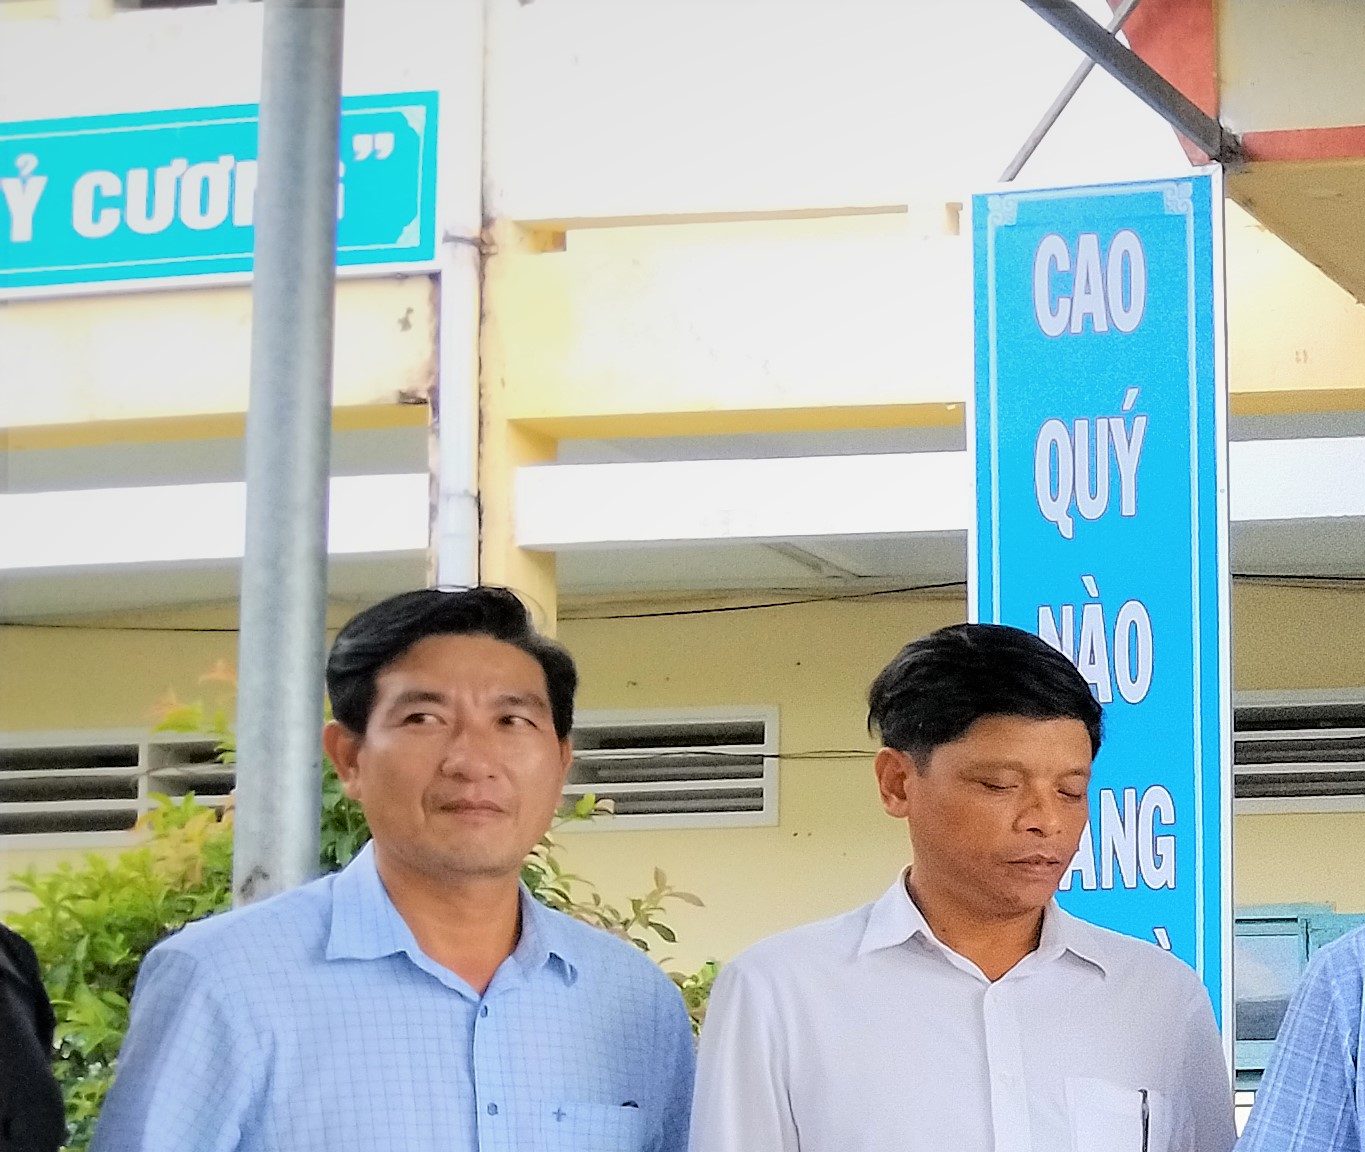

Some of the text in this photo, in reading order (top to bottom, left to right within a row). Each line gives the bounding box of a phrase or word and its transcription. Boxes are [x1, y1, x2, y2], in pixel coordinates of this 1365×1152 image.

[1033, 228, 1147, 337] CAO
[1034, 387, 1148, 540] QUÝ
[1037, 574, 1155, 704] NÀO
